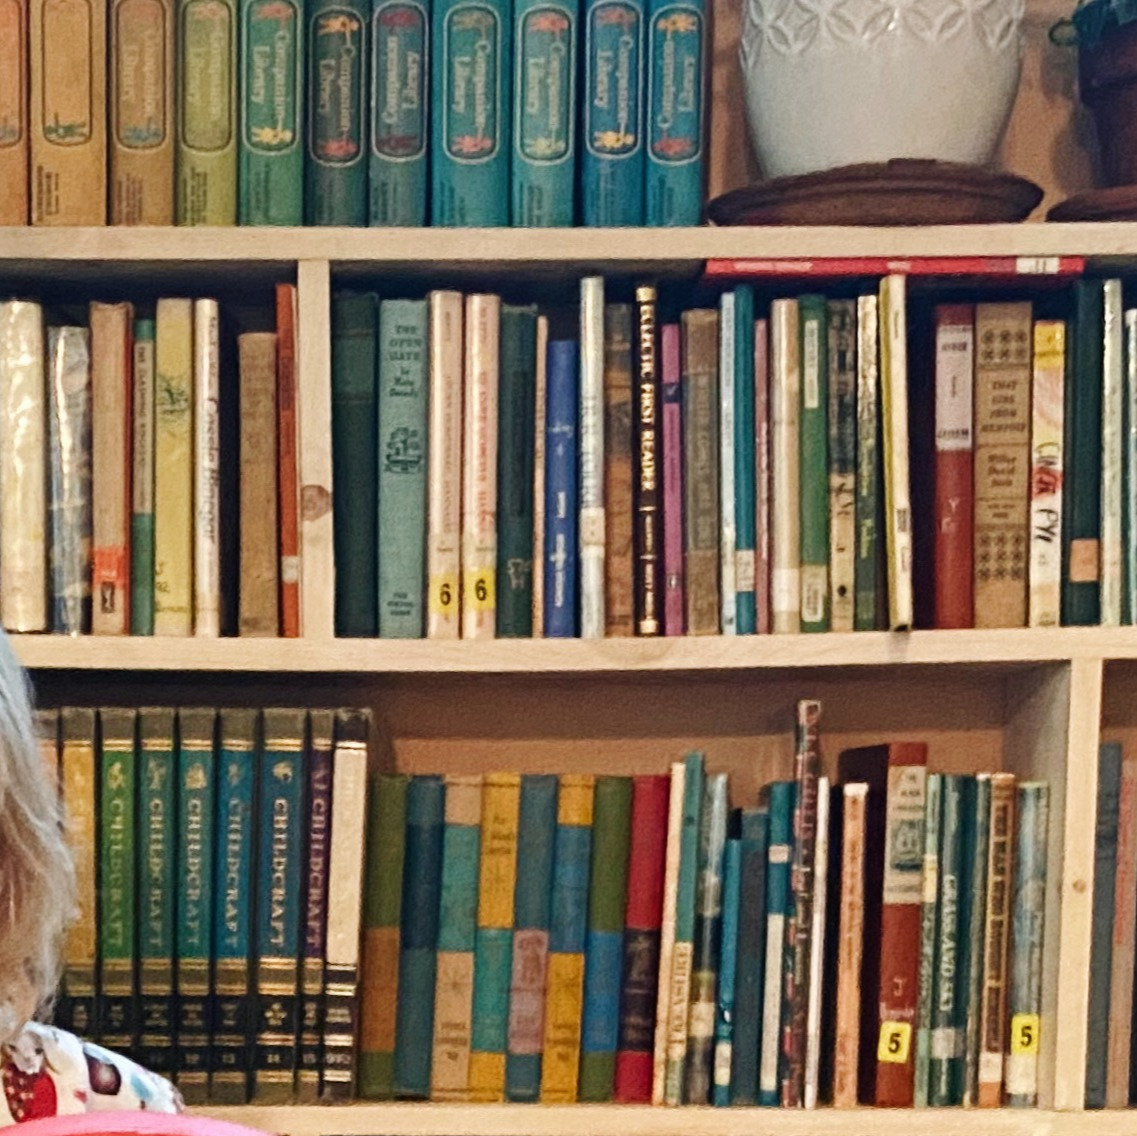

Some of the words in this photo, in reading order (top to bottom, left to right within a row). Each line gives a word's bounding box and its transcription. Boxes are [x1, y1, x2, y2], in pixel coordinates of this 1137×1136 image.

[252, 46, 270, 103] Library
[272, 30, 289, 117] Companion
[318, 59, 335, 115] Library
[338, 43, 356, 132] Companion
[382, 36, 399, 124] Companion
[401, 51, 420, 109] Library
[452, 56, 471, 114] Library
[473, 40, 491, 130] Companion
[526, 57, 545, 114] Library
[547, 42, 565, 129] Companion
[594, 51, 612, 109] Library
[616, 35, 634, 124] Companion
[657, 40, 676, 128] Companion
[678, 56, 696, 112] Library
[639, 304, 655, 378] ECLECTIC
[639, 383, 655, 424] FIRST
[639, 430, 655, 491] READER
[440, 583, 451, 606] 6
[475, 578, 487, 602] 6
[106, 799, 123, 947] CHILDCRAFT
[148, 798, 163, 948] CHILDCRAFT
[185, 799, 202, 947] CHILDCRAFT
[224, 798, 241, 947] CHILDCRAFT
[271, 798, 289, 947] CHILDCRAFT
[307, 798, 326, 947] CHILDCRAFT
[943, 874, 957, 933] GRASS
[940, 935, 955, 977] AND
[889, 1033, 900, 1053] 5
[1020, 1025, 1032, 1046] 5
